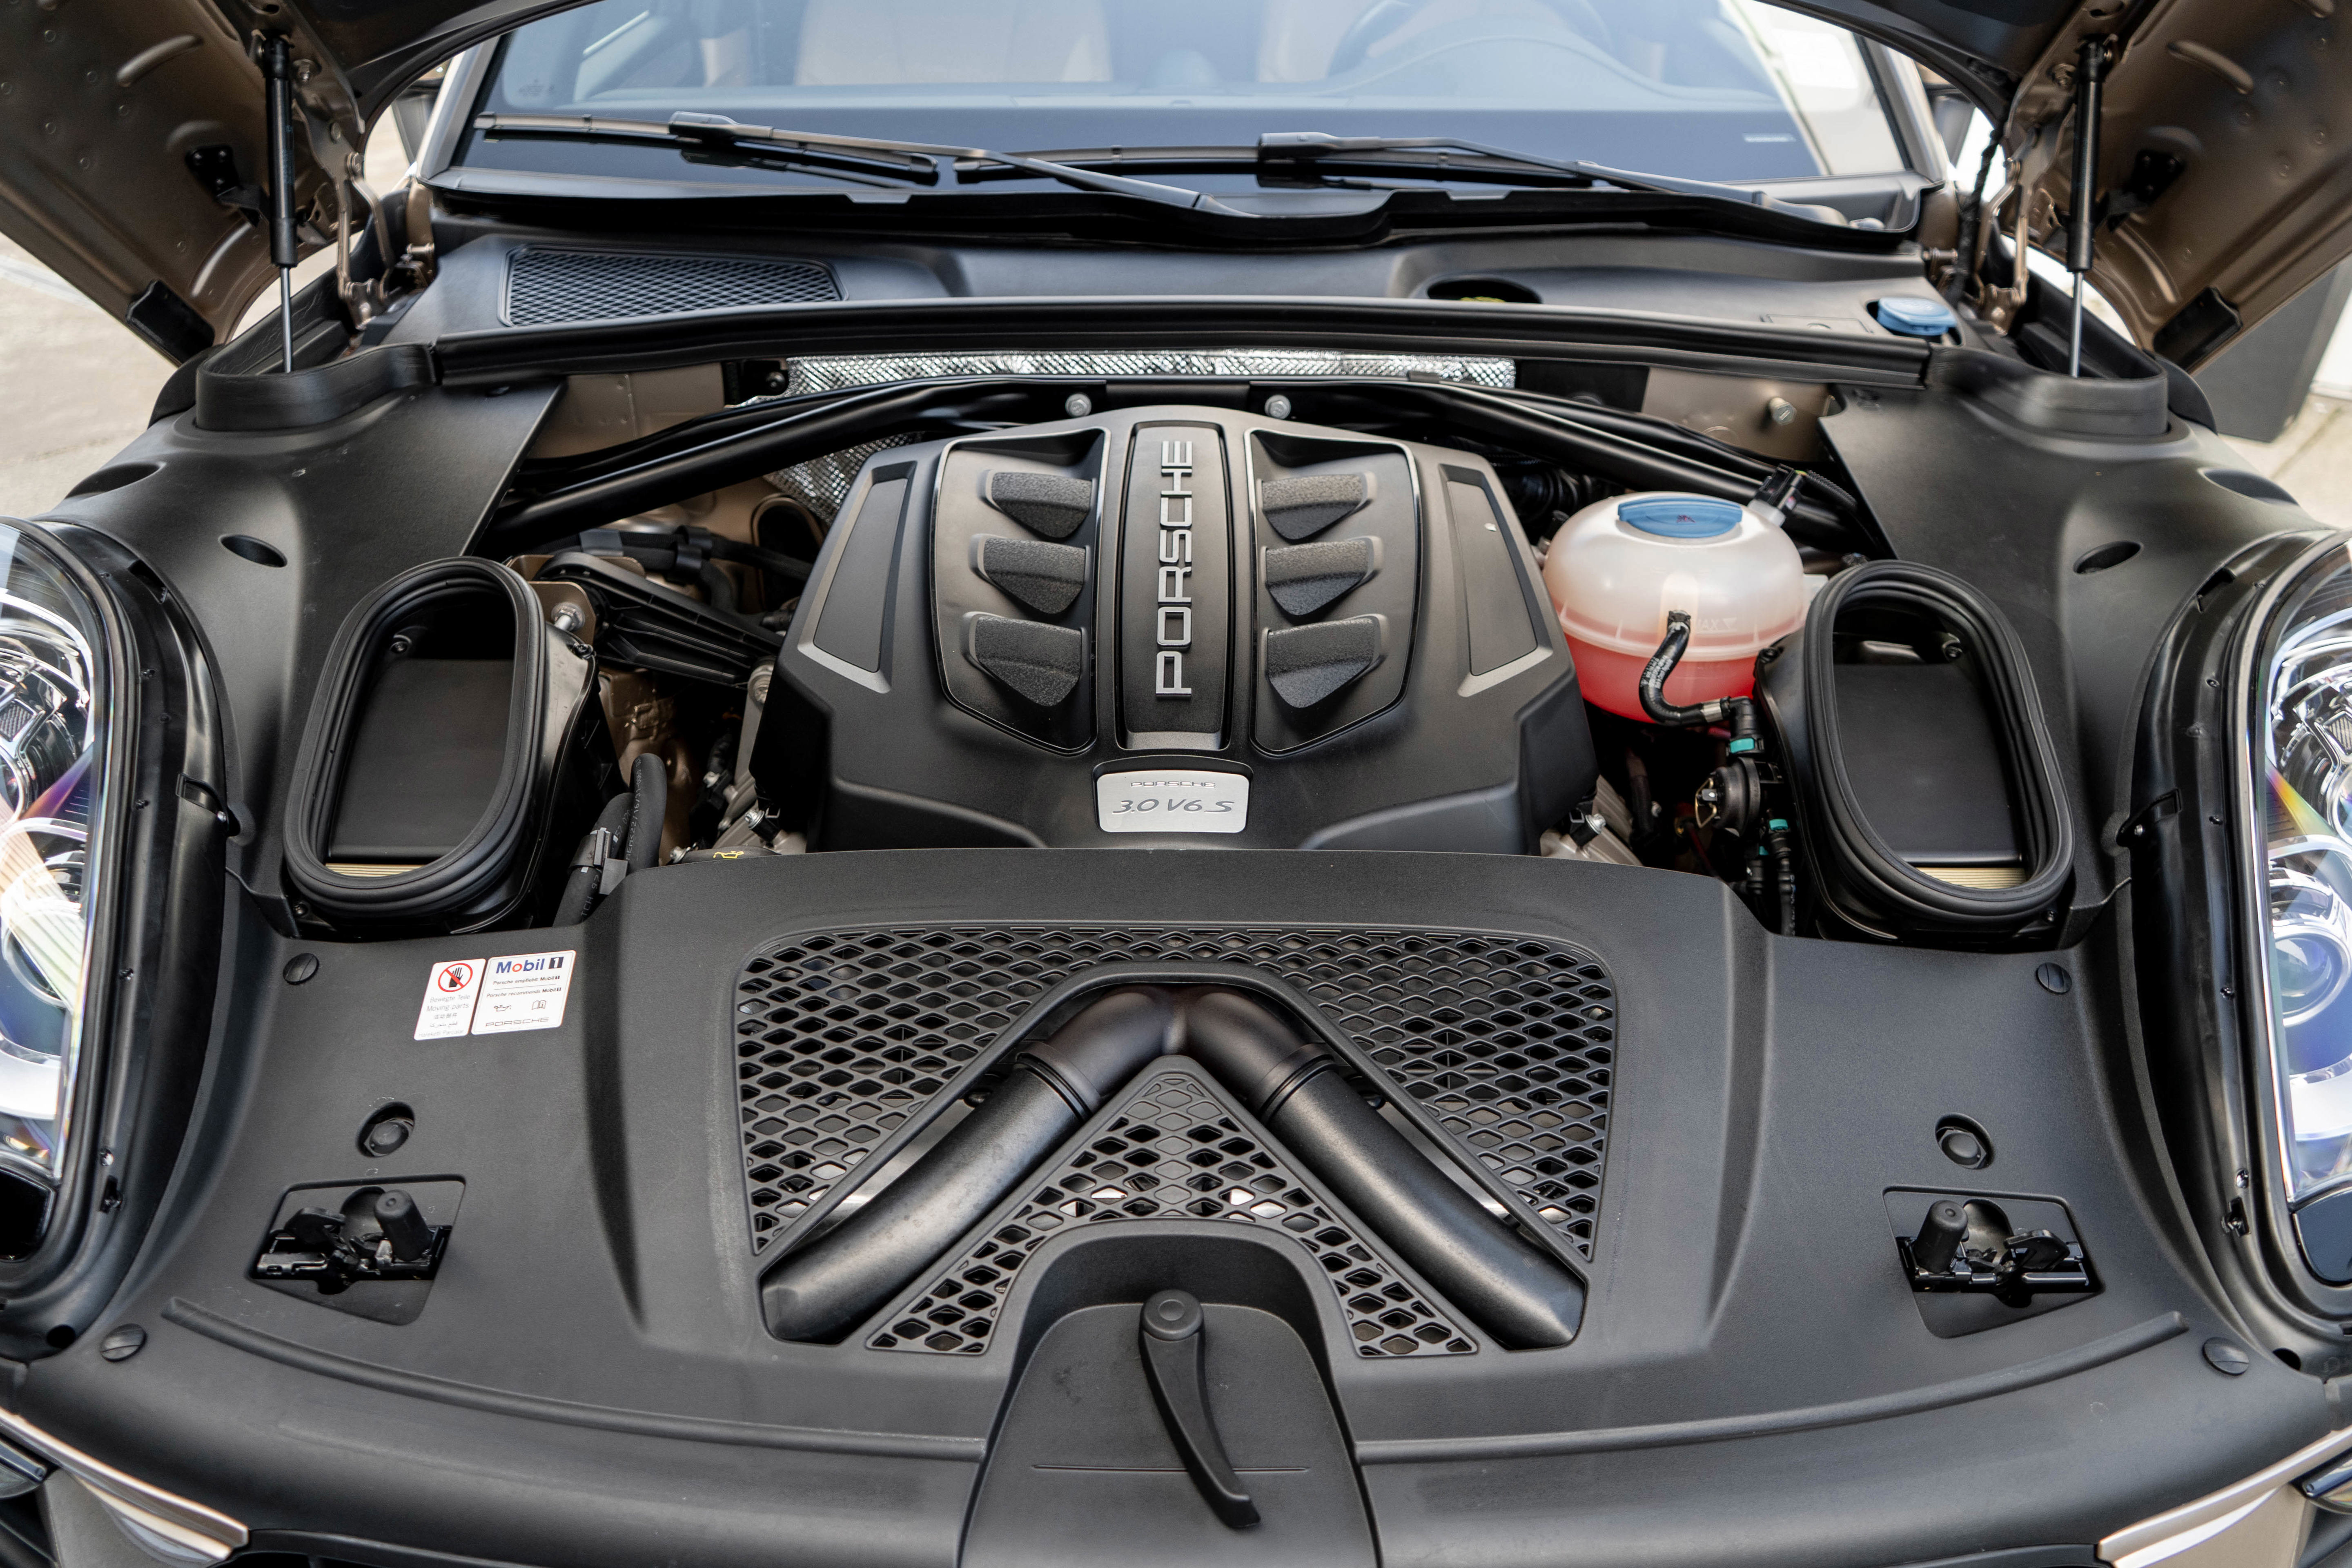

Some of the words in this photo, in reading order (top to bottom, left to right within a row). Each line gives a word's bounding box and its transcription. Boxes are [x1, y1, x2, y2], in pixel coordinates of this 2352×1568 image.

[1156, 441, 1192, 696] PORSCHE
[1112, 799, 1160, 814] 3.0
[1167, 799, 1203, 812] V6
[1204, 801, 1235, 813] S
[496, 958, 545, 974] Mobil
[485, 1017, 549, 1027] PORSCHE
